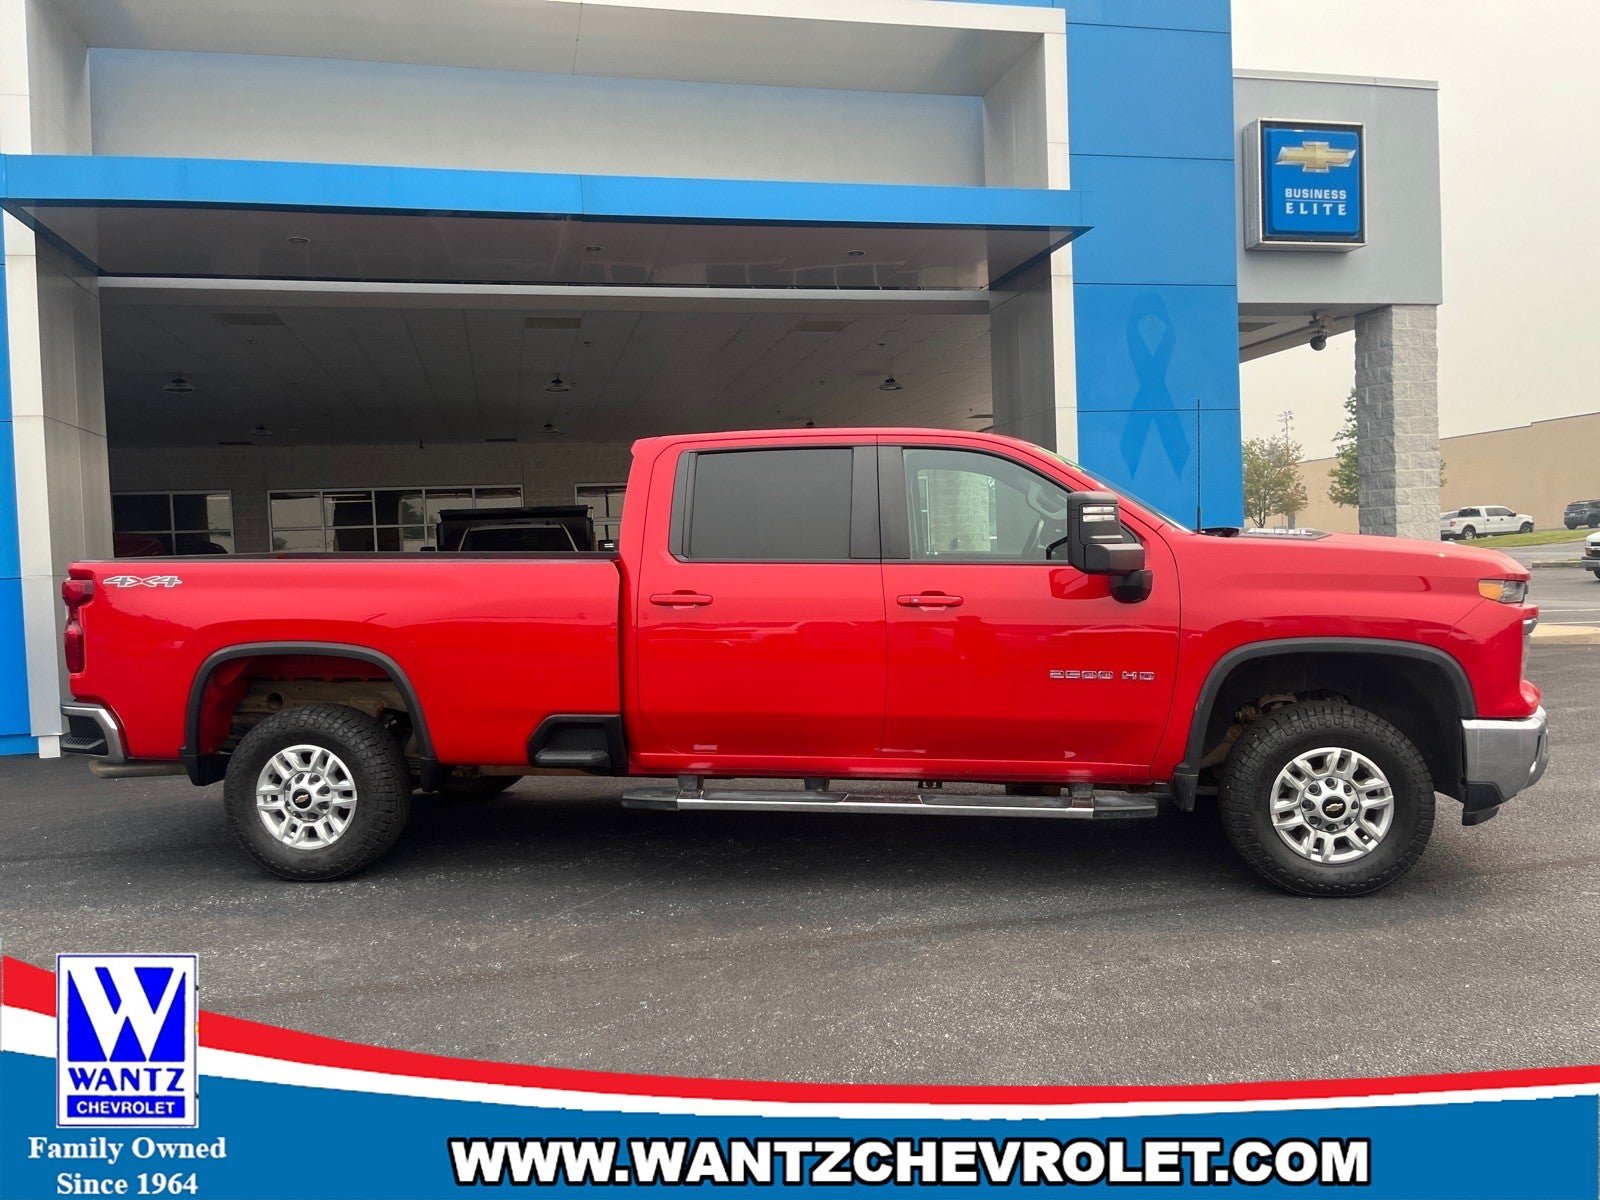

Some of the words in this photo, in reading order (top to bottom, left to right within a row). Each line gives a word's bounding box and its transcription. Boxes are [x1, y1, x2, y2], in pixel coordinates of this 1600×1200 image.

[1284, 188, 1347, 200] BUSINESS
[1285, 202, 1347, 216] ELITE
[1049, 669, 1114, 680] 2500
[1121, 670, 1155, 681] HD
